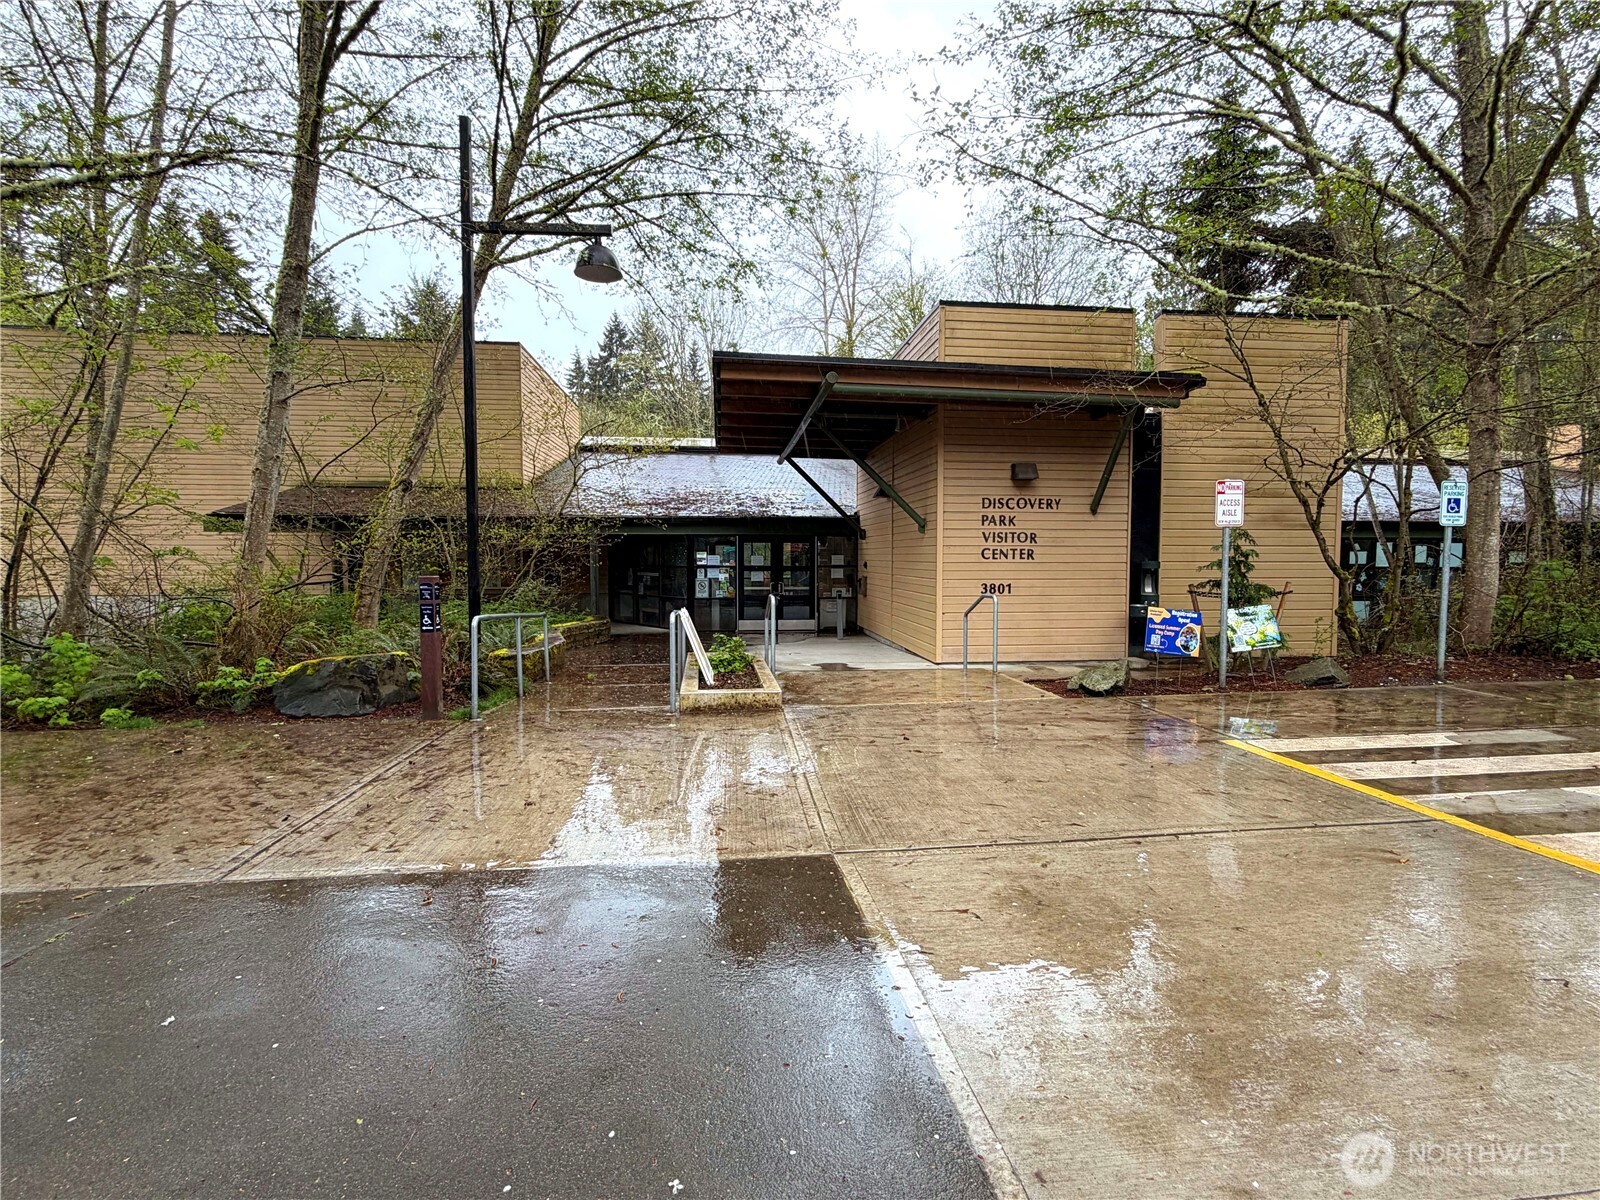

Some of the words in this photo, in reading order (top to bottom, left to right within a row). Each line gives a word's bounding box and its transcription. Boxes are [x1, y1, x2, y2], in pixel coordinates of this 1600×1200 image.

[981, 497, 1062, 510] DISCOVERY
[981, 514, 1017, 527] PARK
[981, 531, 1038, 544] VISITOR
[980, 547, 1036, 561] CENTER
[980, 582, 1012, 595] 3801
